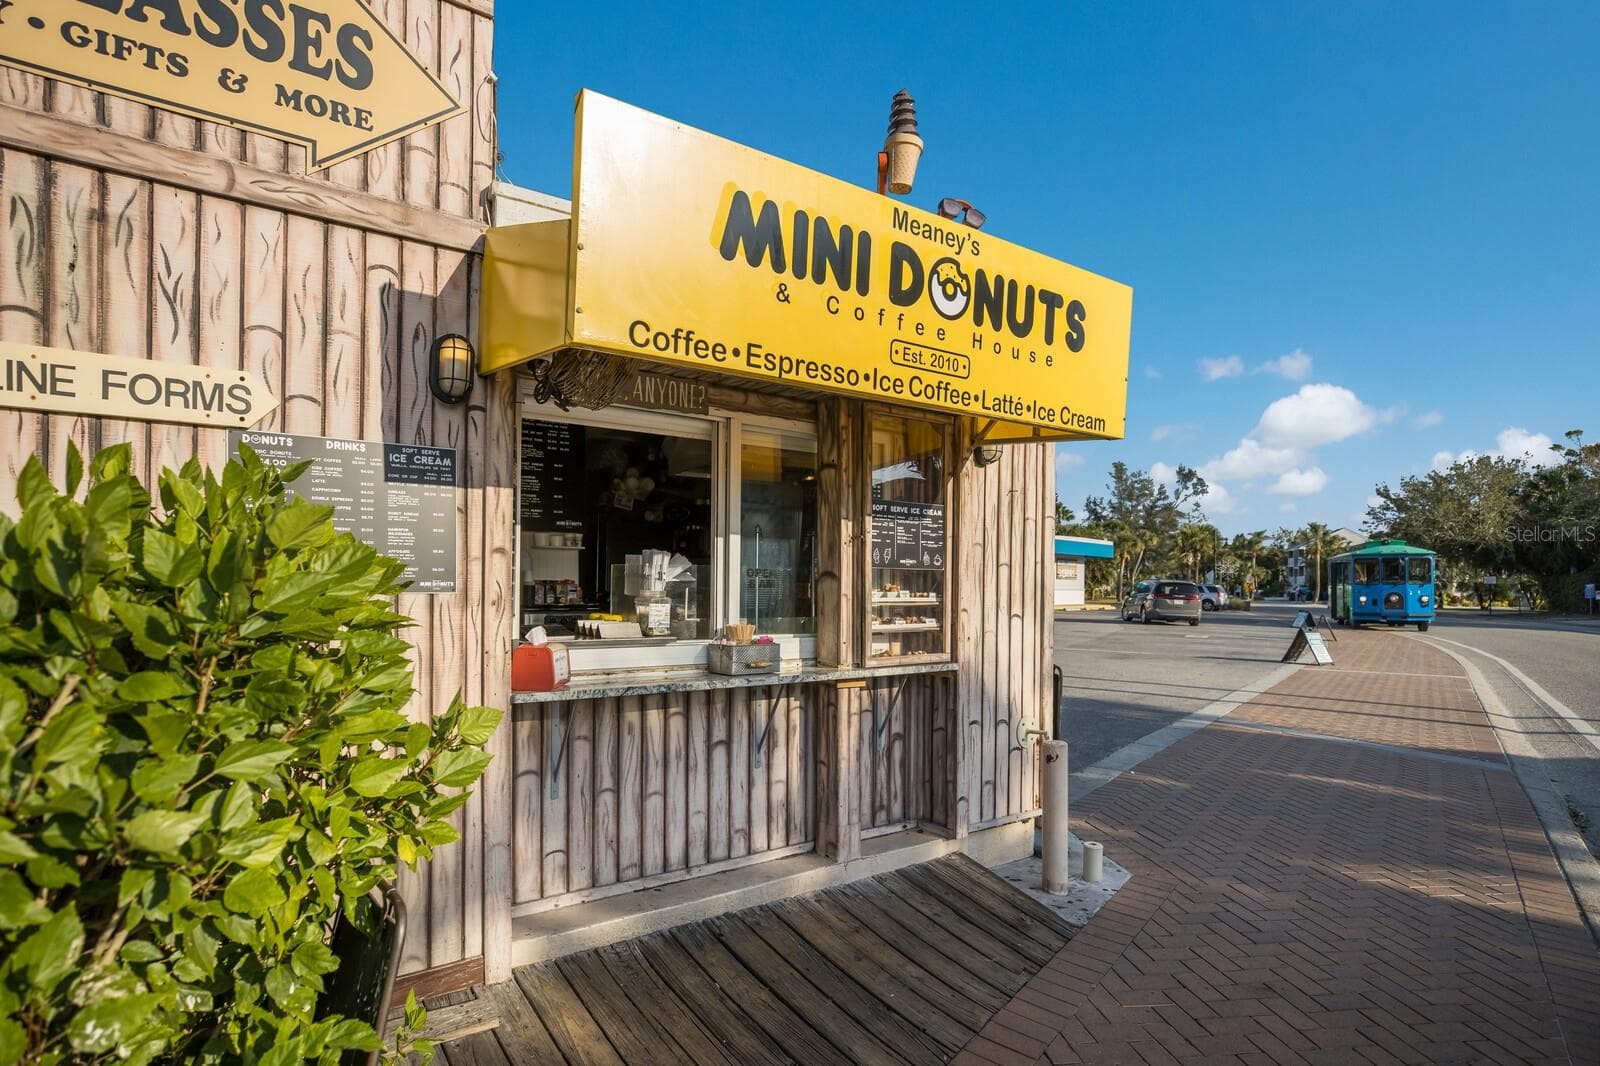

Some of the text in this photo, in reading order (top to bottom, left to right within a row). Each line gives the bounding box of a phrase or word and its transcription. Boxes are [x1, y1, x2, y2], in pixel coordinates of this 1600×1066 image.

[60, 21, 374, 132] GIFTS & MORE
[892, 207, 981, 256] Meaney's
[719, 190, 1086, 353] MINI DONUTS
[776, 283, 1053, 367] & Coffee House
[628, 320, 1106, 432] Coffee Espresso Ice Coffee Latté Ice Cream
[902, 346, 959, 372] Est. 2010
[0, 358, 253, 416] INE FORMS
[632, 375, 706, 409] ANYONE?
[241, 433, 293, 447] DONUTS
[326, 440, 366, 452] DRINKS
[389, 453, 452, 466] ICE CREAM
[890, 505, 908, 513] SERVE
[910, 507, 921, 515] ICE
[922, 508, 943, 516] CREAM
